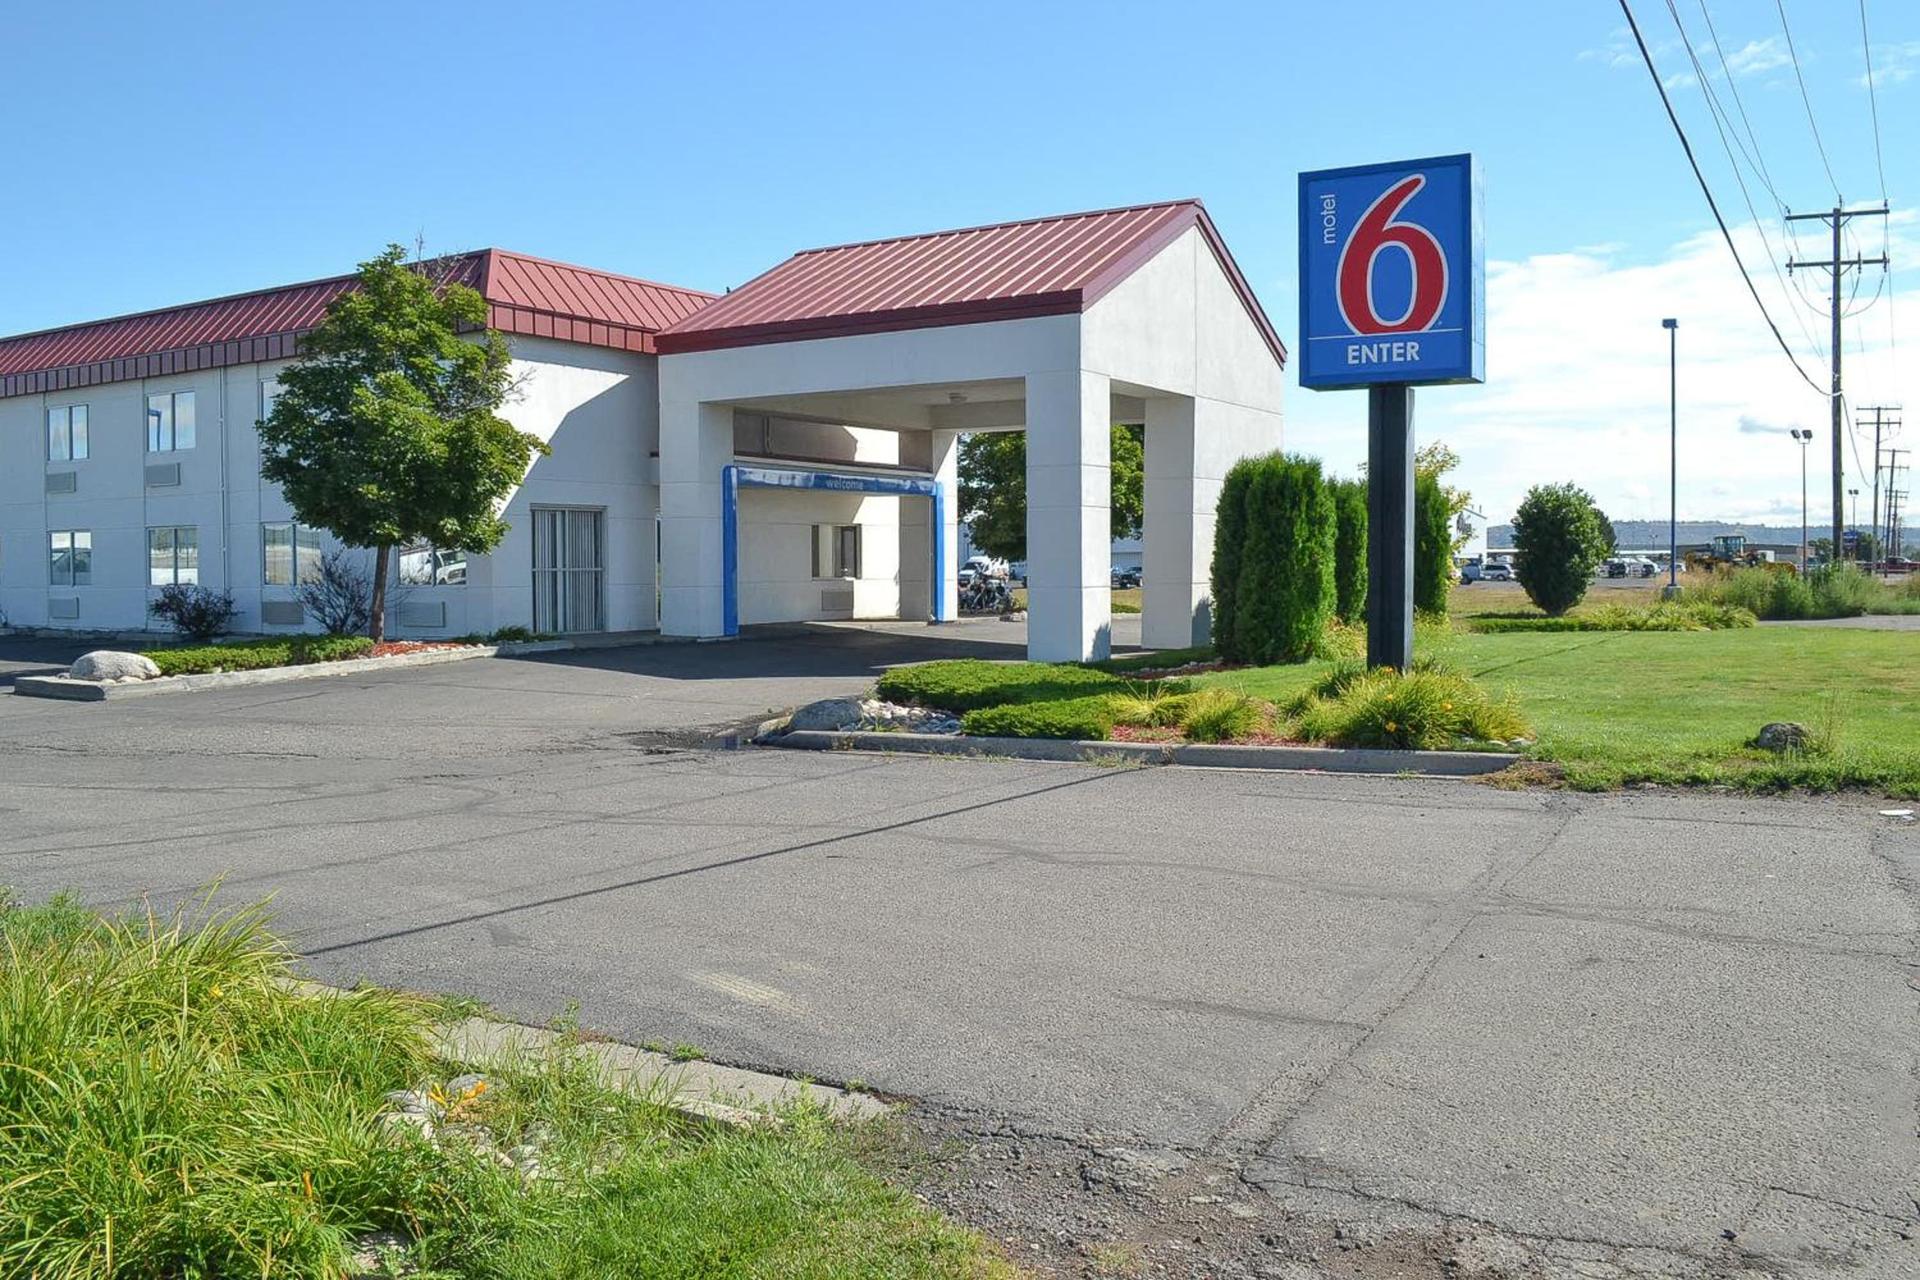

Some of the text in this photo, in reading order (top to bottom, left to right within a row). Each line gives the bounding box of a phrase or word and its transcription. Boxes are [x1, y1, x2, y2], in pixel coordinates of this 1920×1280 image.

[1320, 174, 1449, 336] motel 6
[1347, 342, 1420, 365] ENTER
[826, 479, 864, 490] welcome
